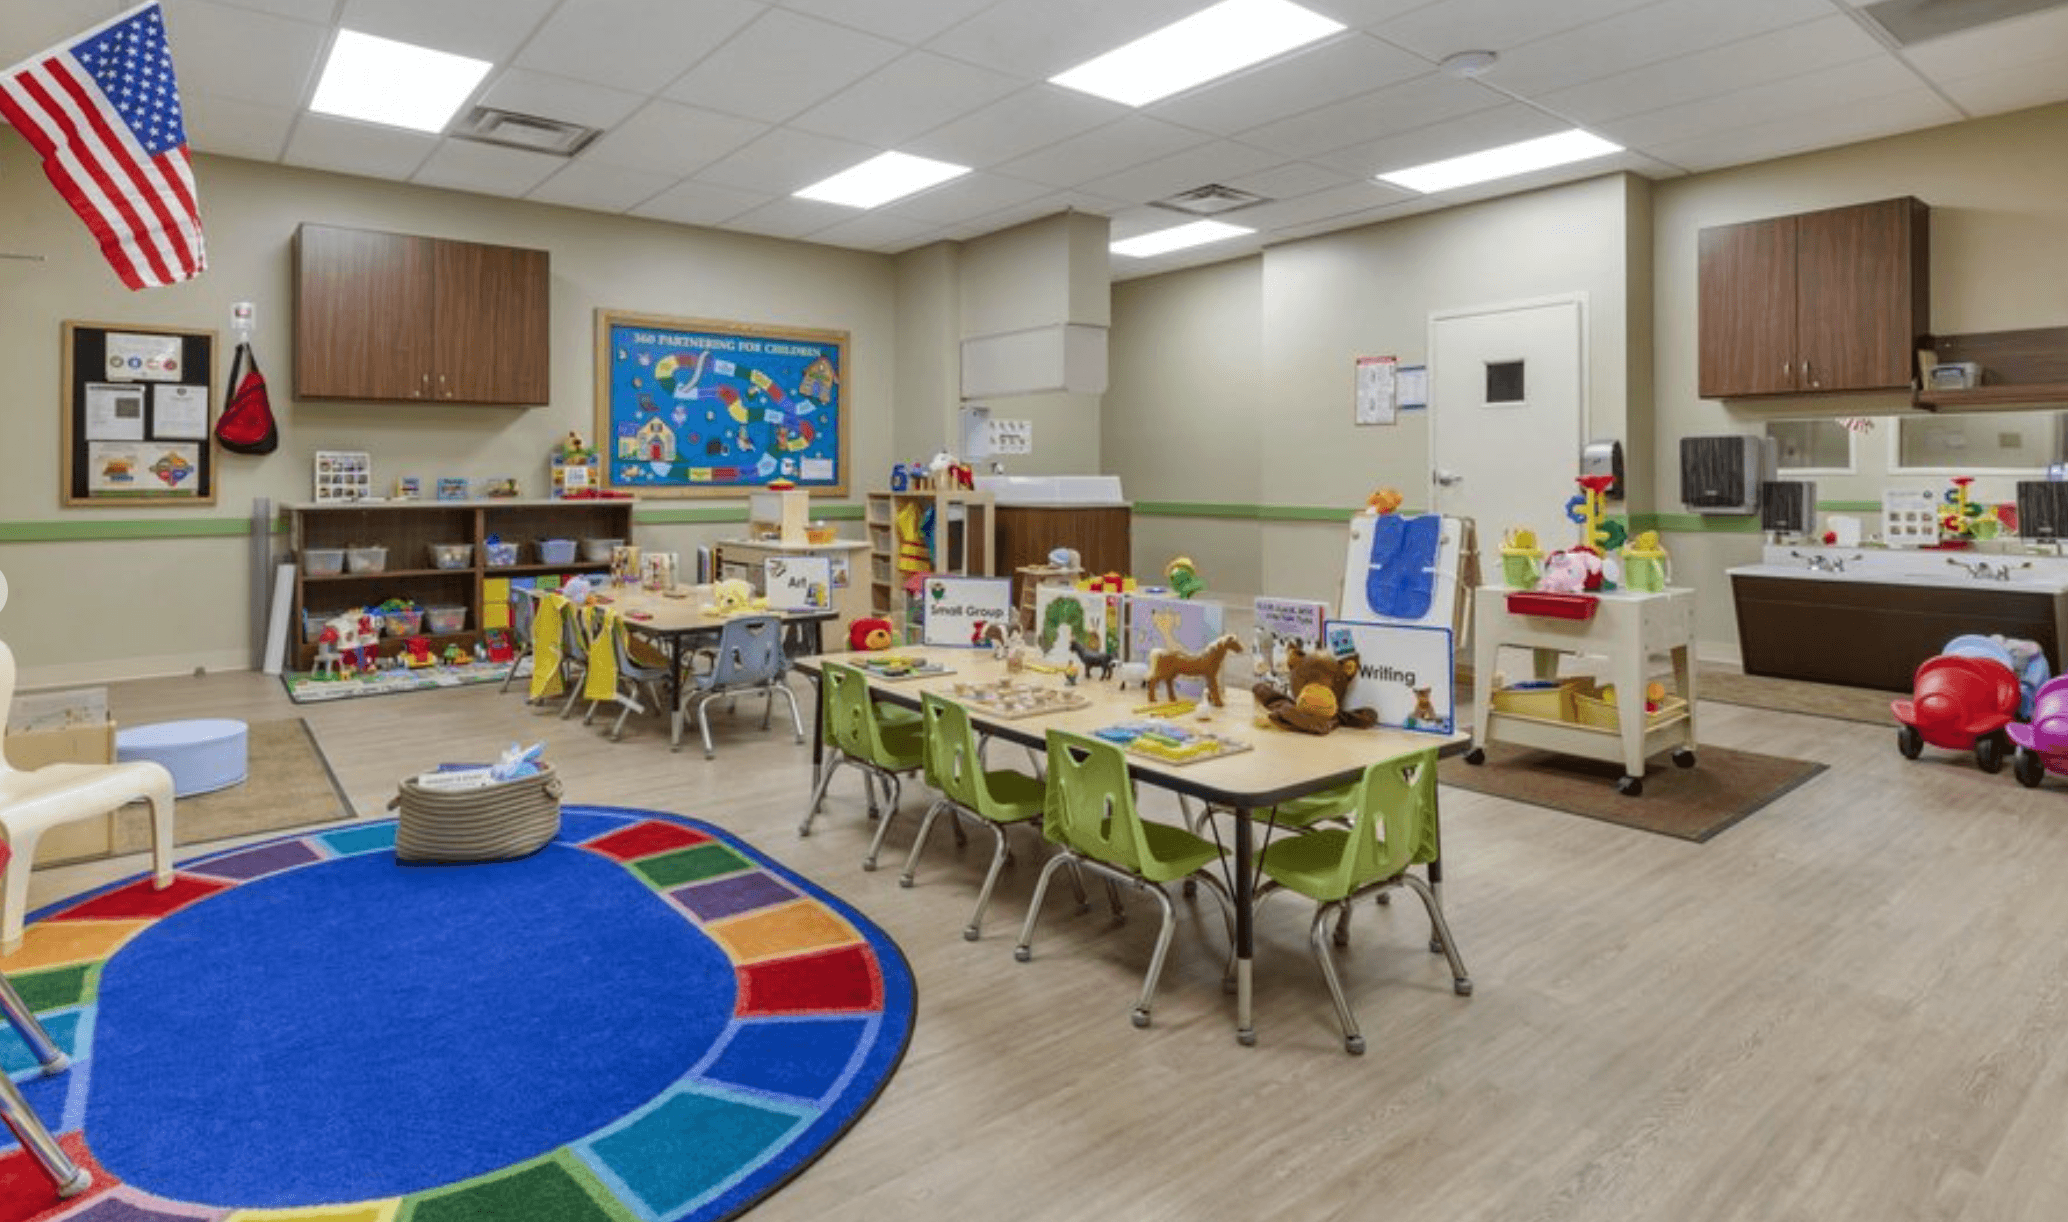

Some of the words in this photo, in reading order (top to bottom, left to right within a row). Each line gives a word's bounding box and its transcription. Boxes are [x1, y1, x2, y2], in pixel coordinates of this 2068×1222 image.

[634, 333, 656, 345] 360
[658, 335, 736, 351] PARTNERING
[739, 341, 762, 353] FOR
[764, 343, 821, 357] CHILDREN
[788, 576, 807, 589] Art
[931, 604, 962, 617] Small
[966, 605, 1004, 619] Group
[1360, 664, 1416, 688] Writing
